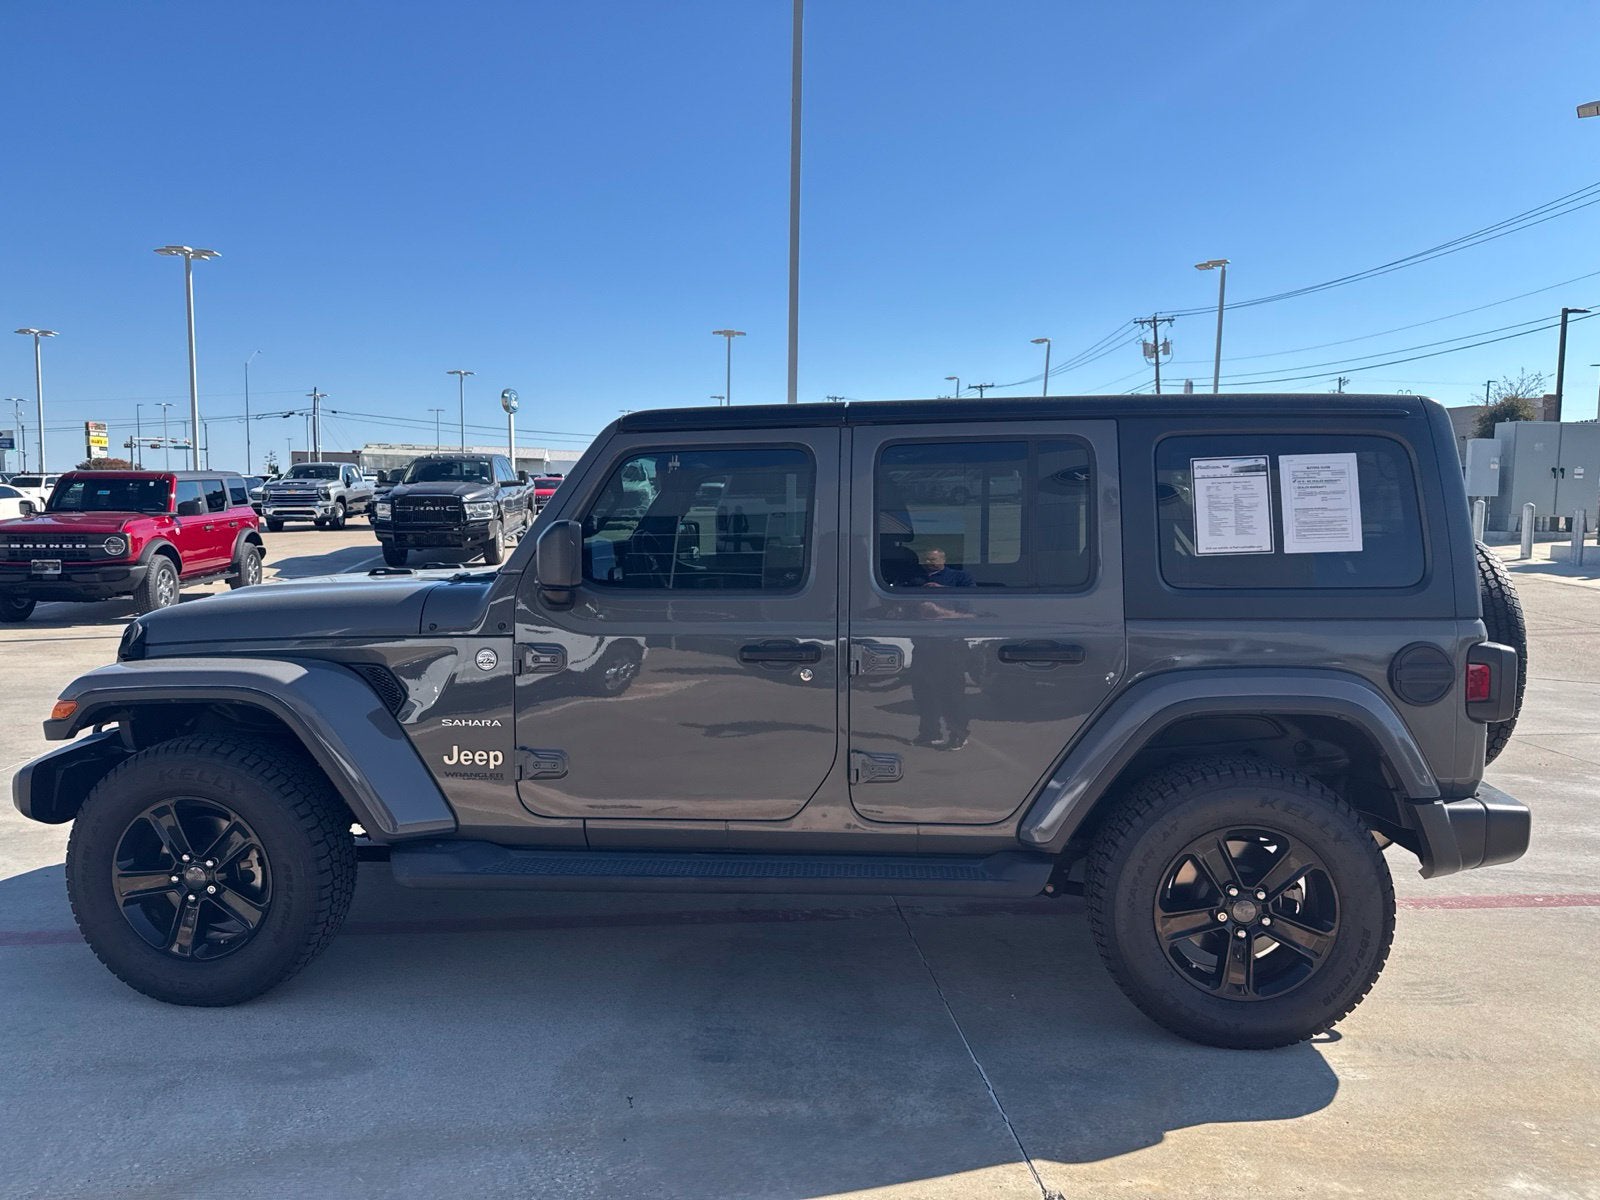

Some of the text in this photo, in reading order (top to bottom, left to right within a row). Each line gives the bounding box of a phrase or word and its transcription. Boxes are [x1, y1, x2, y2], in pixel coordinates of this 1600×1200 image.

[441, 718, 502, 727] SAHARA
[443, 745, 504, 769] Jeep
[1255, 797, 1346, 844] KELLY
